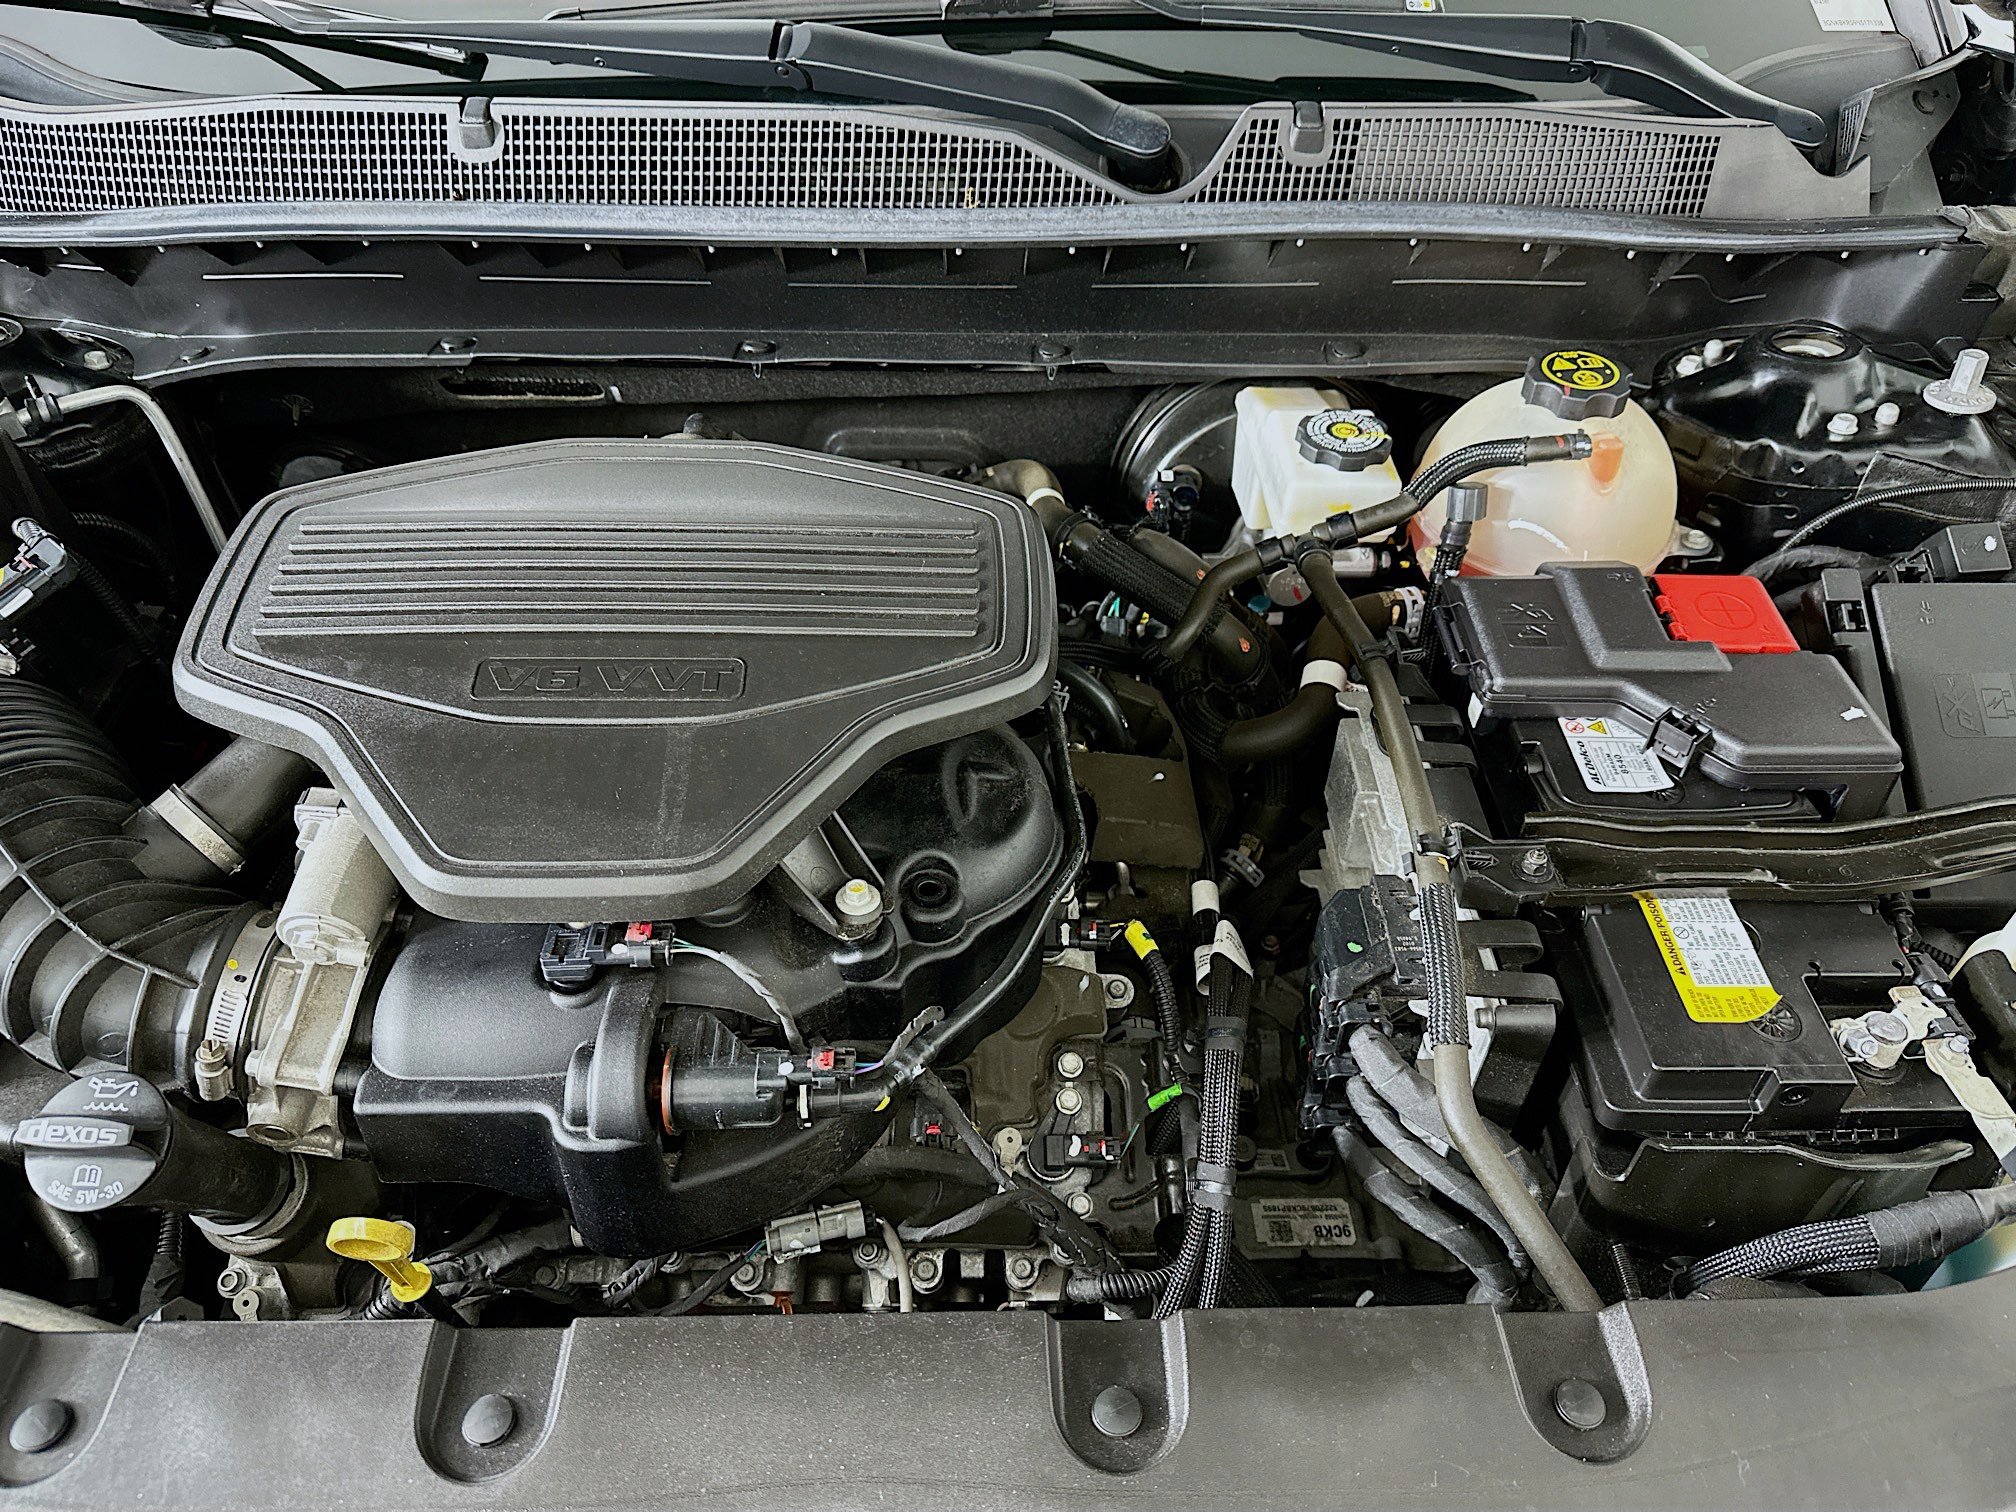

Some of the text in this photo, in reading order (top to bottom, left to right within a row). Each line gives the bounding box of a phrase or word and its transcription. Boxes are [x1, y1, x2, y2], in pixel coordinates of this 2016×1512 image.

[488, 665, 734, 692] V6 VVT
[1577, 741, 1601, 784] ACDelco
[1613, 754, 1629, 774] 8540
[27, 1120, 118, 1144] dexos
[47, 1180, 124, 1204] SAE 5W-30
[1314, 1225, 1352, 1238] 9CKB
